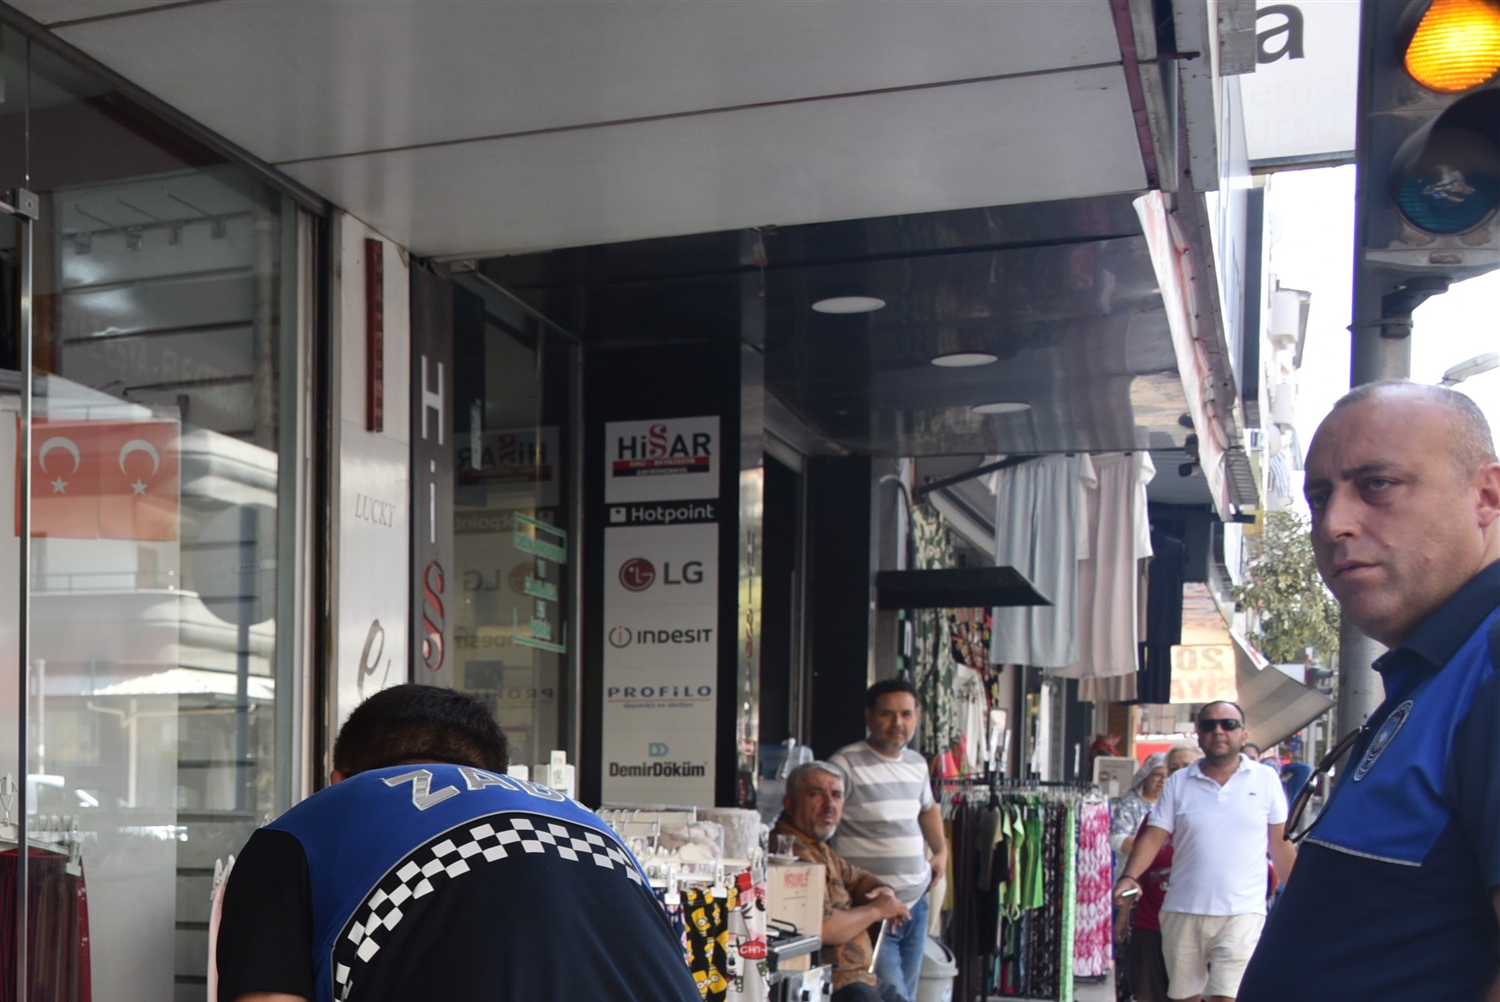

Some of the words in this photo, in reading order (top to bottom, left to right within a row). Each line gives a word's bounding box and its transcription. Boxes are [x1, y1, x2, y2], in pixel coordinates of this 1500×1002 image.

[354, 493, 396, 528] LUCKY
[631, 503, 714, 524] Hotpoint
[663, 560, 704, 585] LG
[609, 761, 706, 778] DemirDöküm
